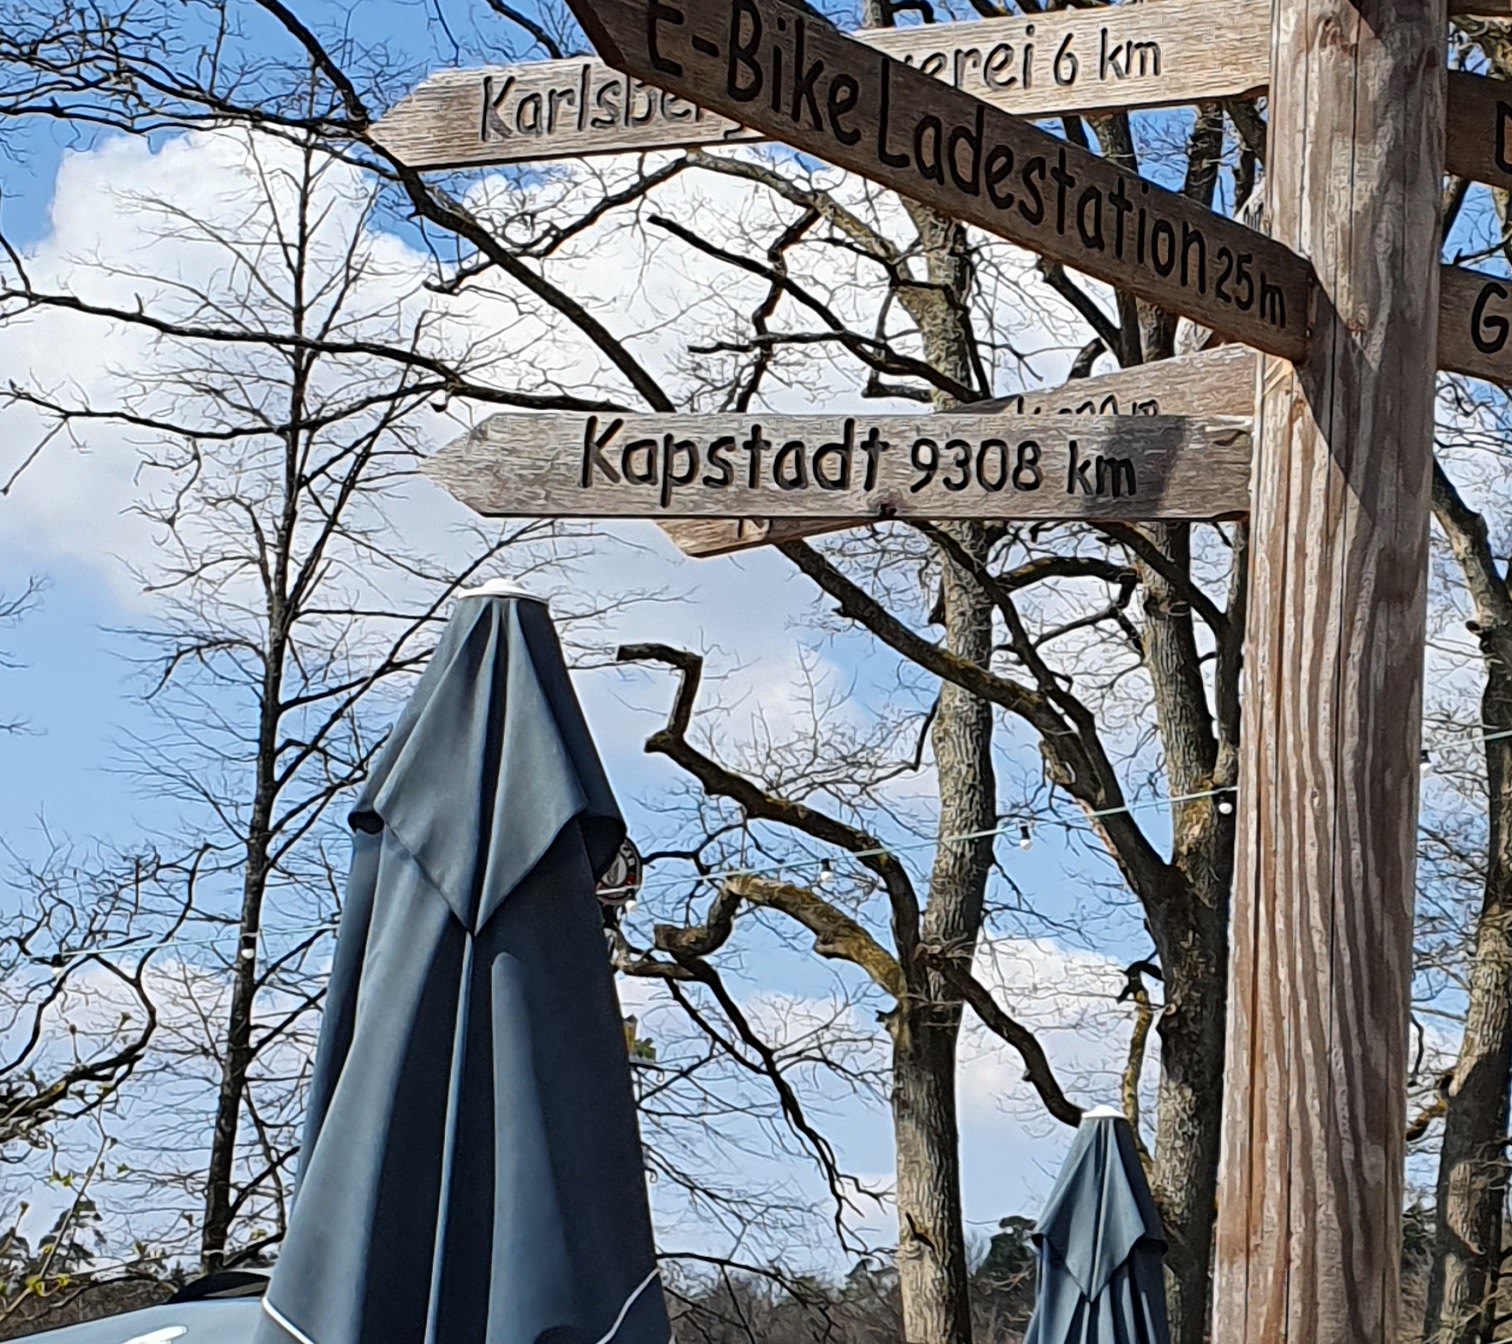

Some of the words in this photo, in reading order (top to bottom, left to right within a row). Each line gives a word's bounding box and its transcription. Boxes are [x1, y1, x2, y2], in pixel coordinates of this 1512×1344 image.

[1053, 33, 1079, 86] 6
[1100, 27, 1161, 80] km
[880, 56, 1208, 290] Ladestation
[1216, 253, 1255, 313] 25
[1260, 284, 1286, 330] m
[580, 417, 890, 508] Kapstadt
[911, 436, 1043, 494] 9308
[1067, 440, 1136, 498] km
